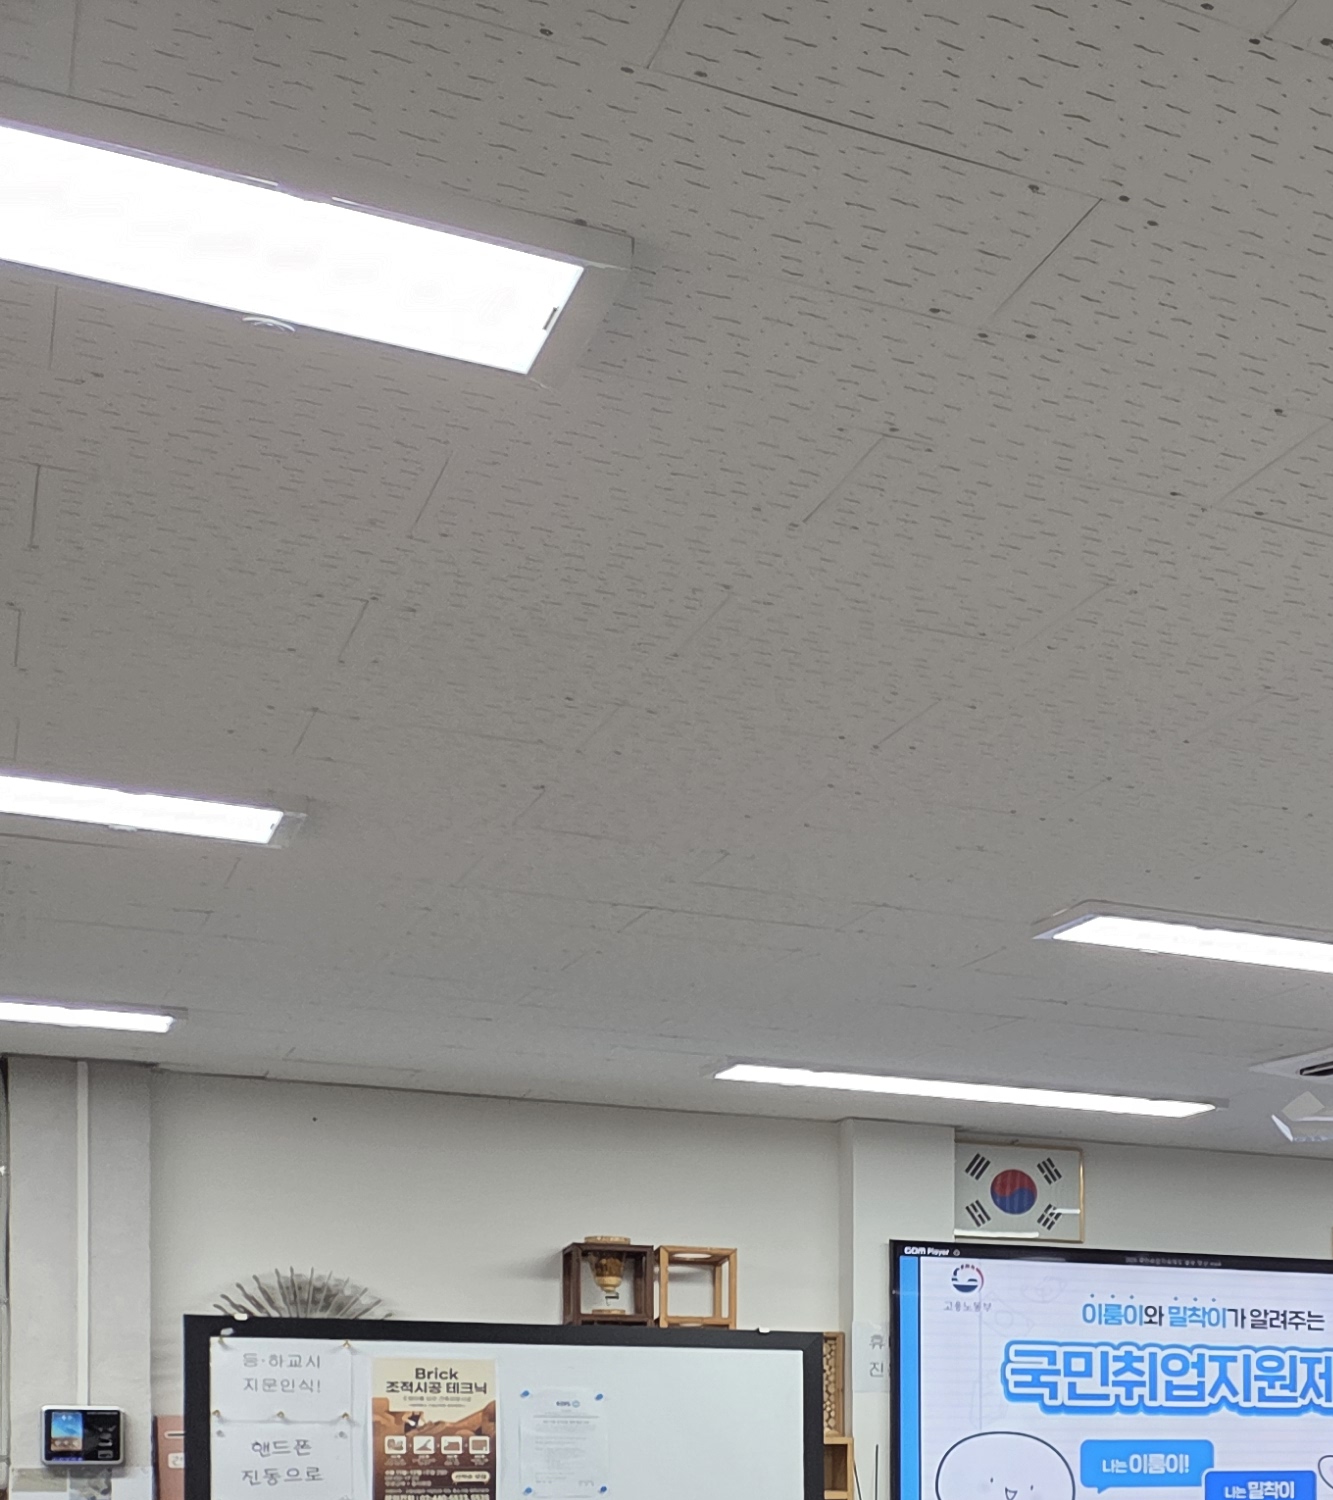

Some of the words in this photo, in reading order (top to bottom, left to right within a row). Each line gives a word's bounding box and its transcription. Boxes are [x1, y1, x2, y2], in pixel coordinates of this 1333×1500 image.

[943, 1301, 992, 1313] 고용노동부
[1082, 1303, 1165, 1327] 이룸이와
[1168, 1305, 1246, 1329] 밀착이가
[1250, 1308, 1326, 1332] 알려주는
[415, 1367, 459, 1381] Brick
[242, 1376, 322, 1394] 지문인식!
[386, 1381, 442, 1395] 조적시공
[445, 1381, 488, 1395] 테크닉
[1102, 1459, 1128, 1475] 나는
[1128, 1454, 1190, 1475] 이룸이!
[241, 1466, 325, 1487] 진동으로
[1224, 1486, 1247, 1500] 나는
[1247, 1481, 1295, 1500] 밀착이
